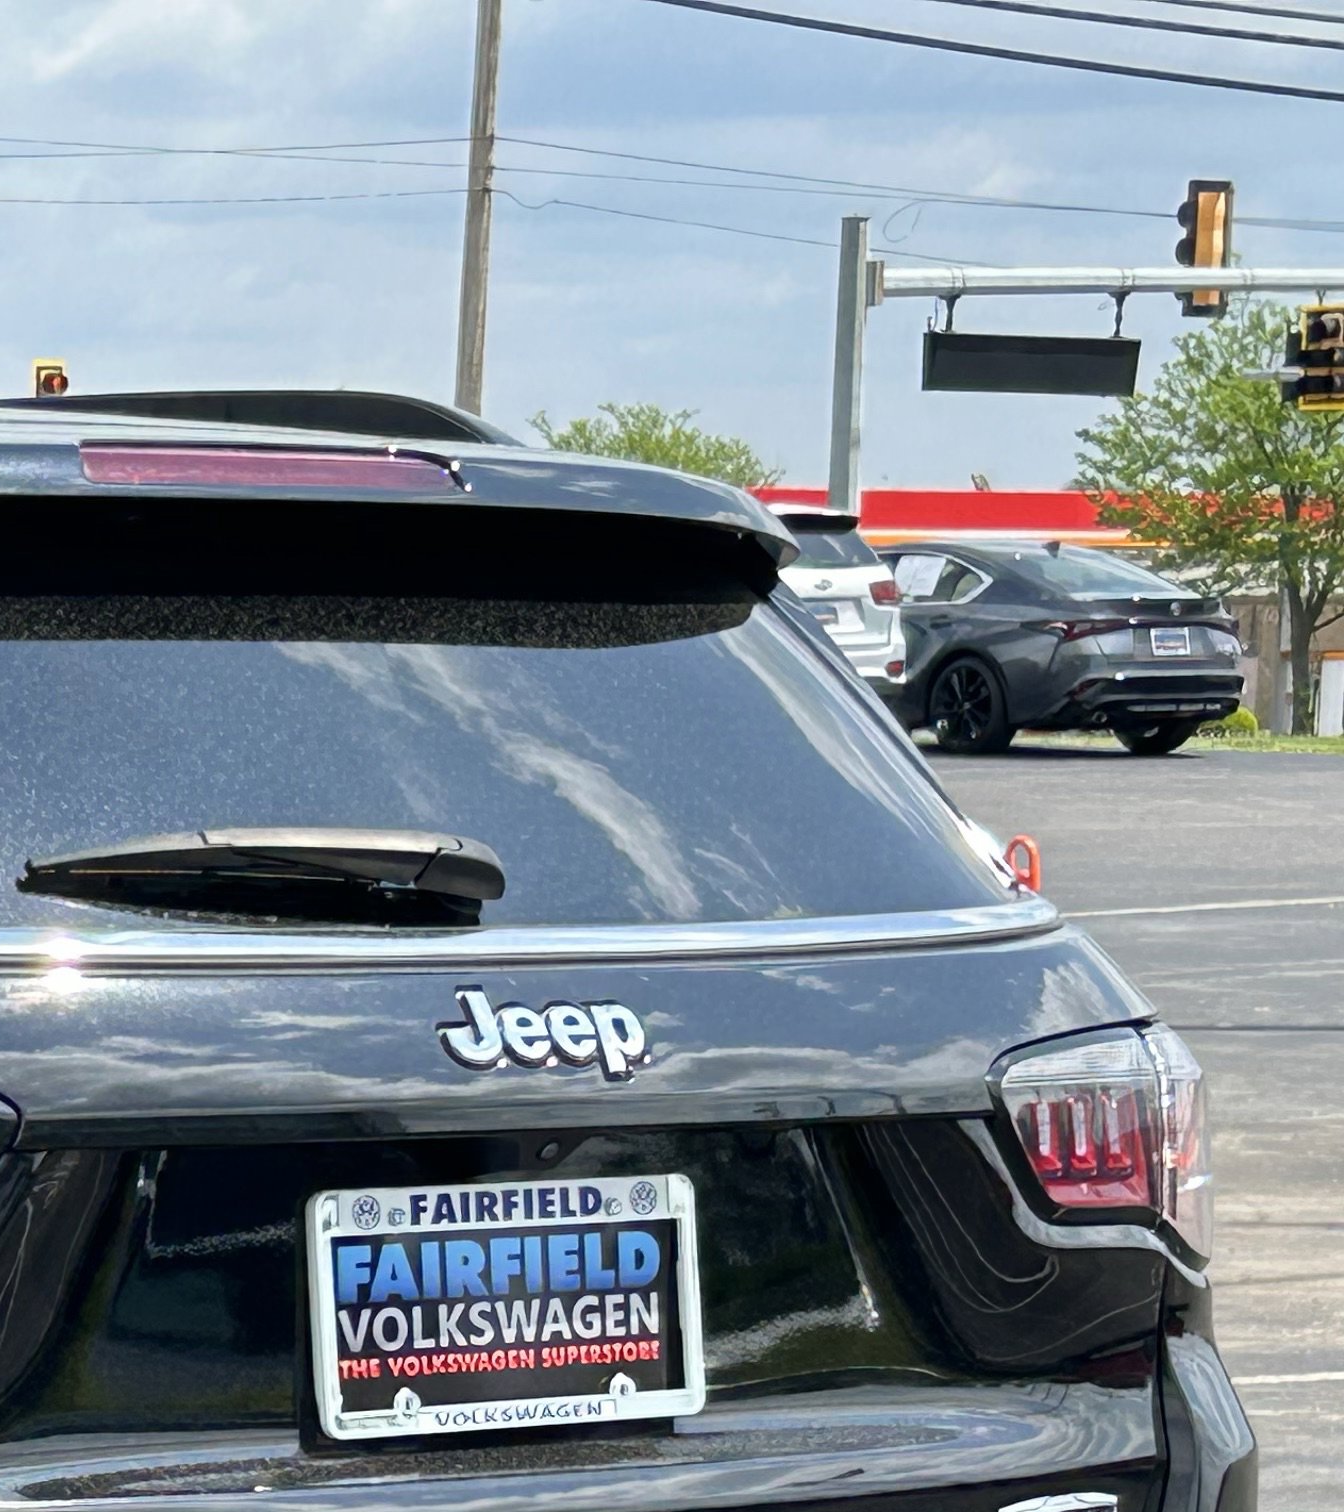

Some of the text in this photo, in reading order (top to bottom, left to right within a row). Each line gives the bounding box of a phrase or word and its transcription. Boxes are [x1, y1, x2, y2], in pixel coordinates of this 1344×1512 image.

[435, 985, 651, 1082] Jeep
[409, 1185, 602, 1226] FAIRFIELD
[337, 1230, 660, 1304] FAIRFIELD
[338, 1291, 660, 1353] VOLKSWAGEN
[339, 1339, 660, 1380] THE VOLKSWAGEN SUPERSTORE
[434, 1399, 603, 1427] VOLKSWAGEN
